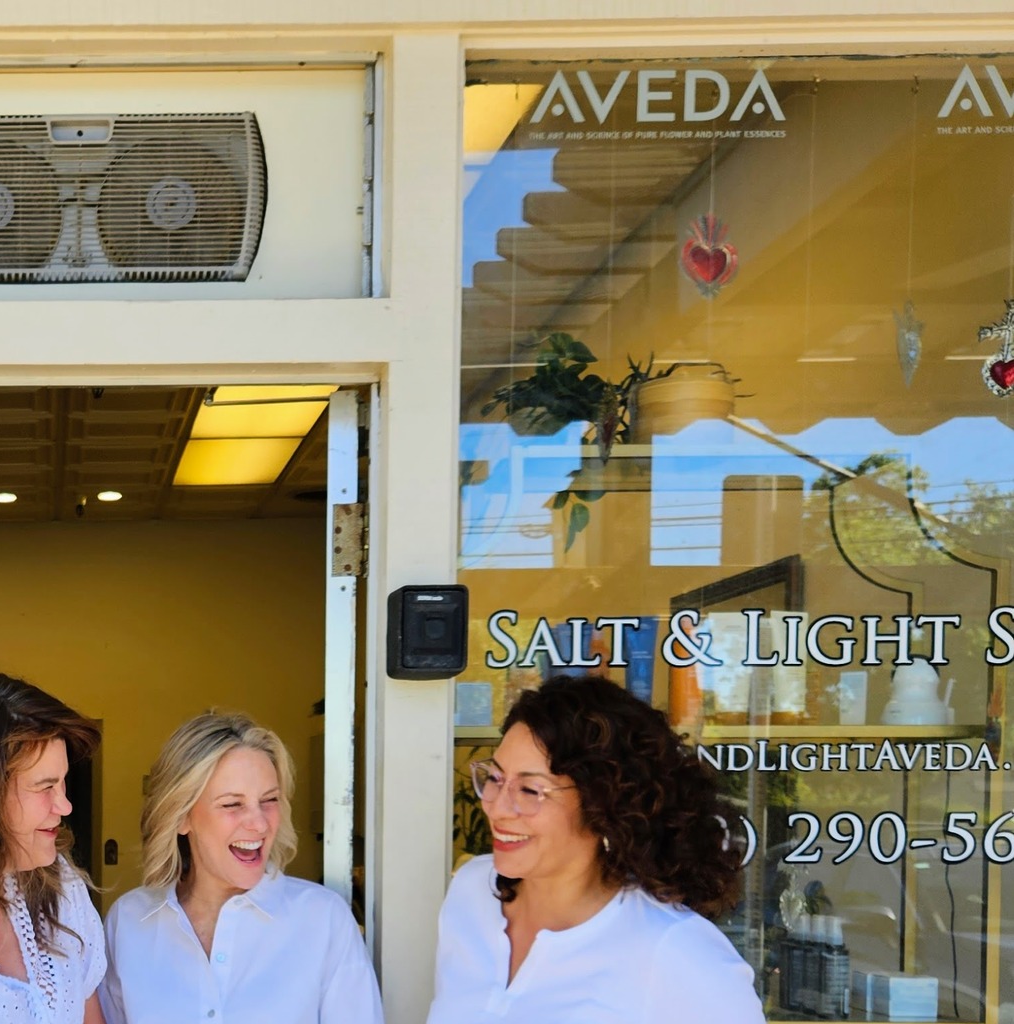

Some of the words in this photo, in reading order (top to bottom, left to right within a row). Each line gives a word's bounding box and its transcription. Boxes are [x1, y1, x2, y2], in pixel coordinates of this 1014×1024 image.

[529, 69, 786, 124] AVEDA
[566, 131, 584, 140] AND
[586, 131, 621, 140] SCIENCE
[635, 130, 658, 139] PURE
[660, 130, 693, 139] FLOWER
[694, 130, 714, 139] AND
[714, 130, 741, 139] PLANT
[743, 130, 786, 139] ESSENCES
[937, 126, 953, 135] THE
[955, 126, 972, 135] ART
[974, 126, 992, 135] AND
[486, 609, 640, 667] SALT
[662, 609, 723, 667] &
[741, 608, 961, 666] LIGHT
